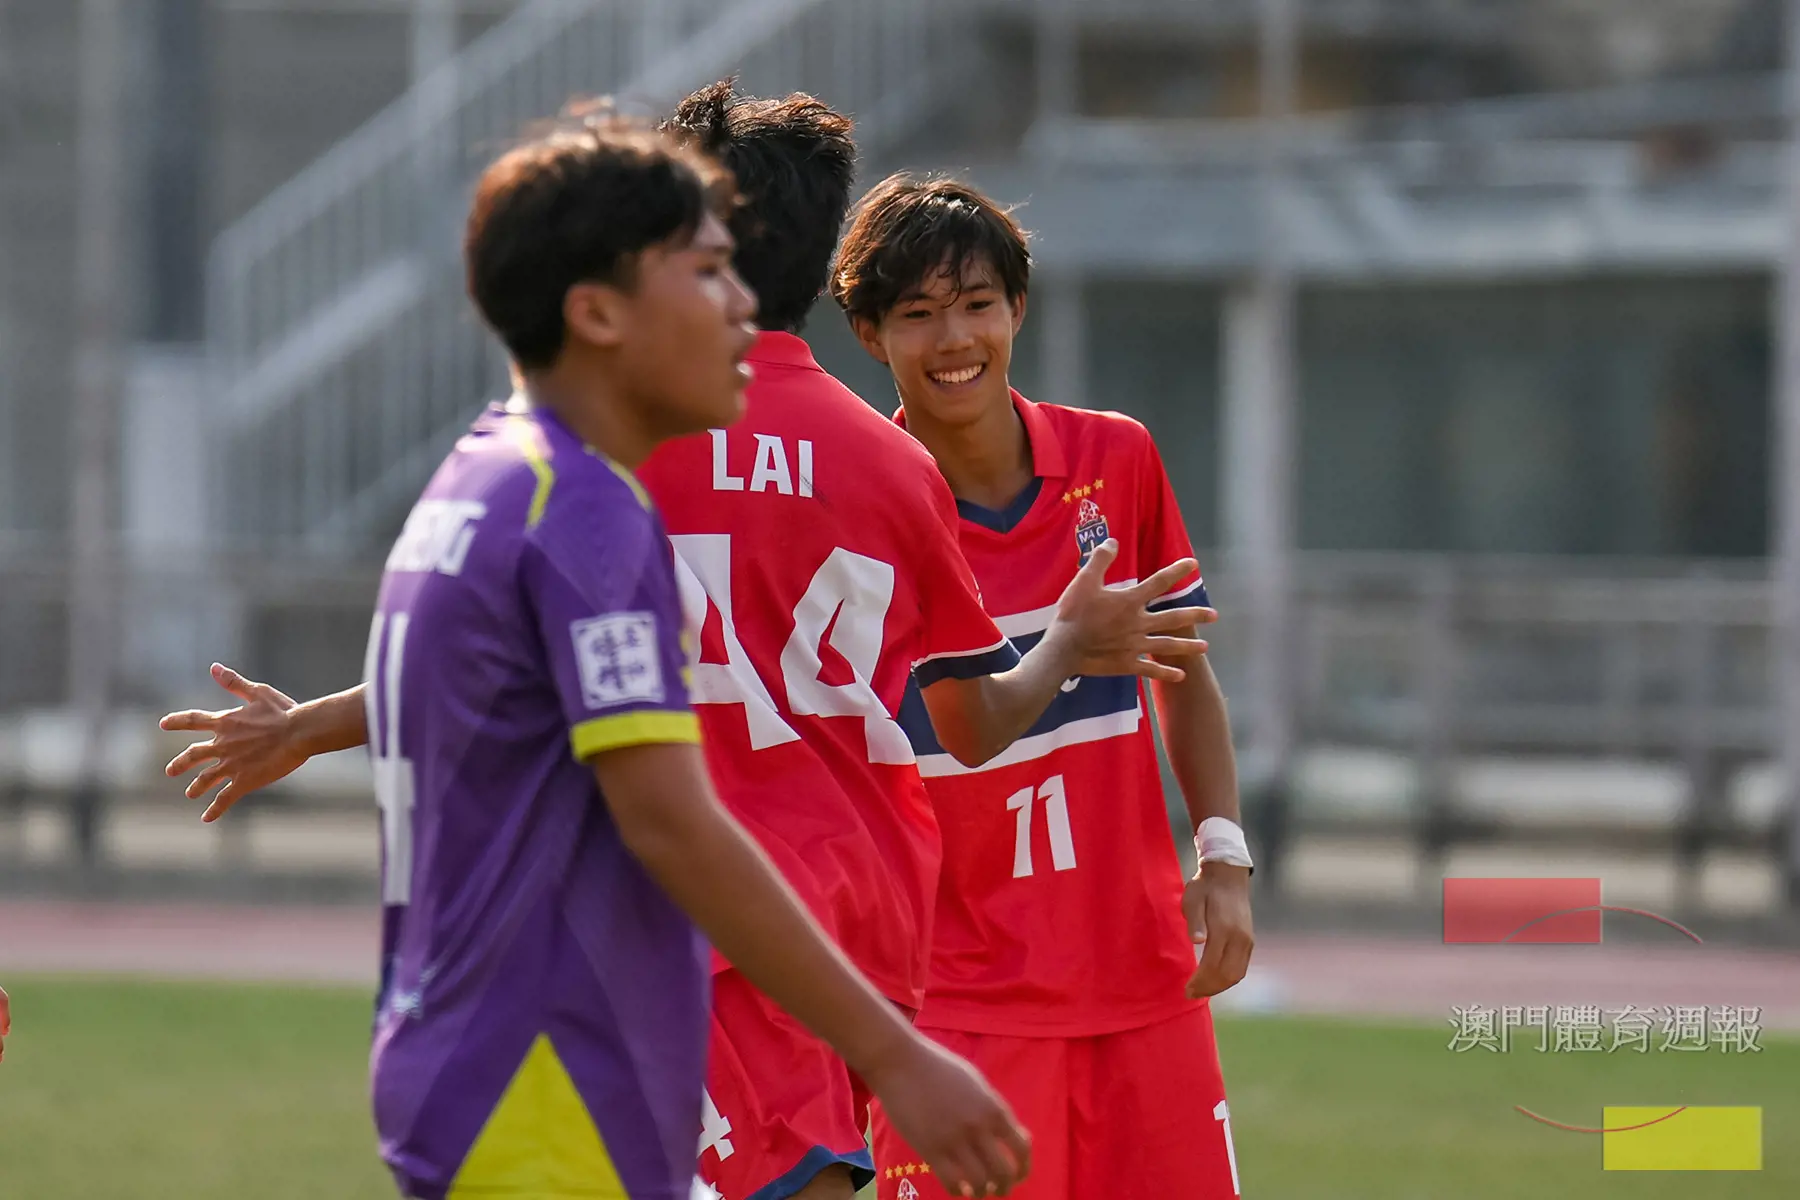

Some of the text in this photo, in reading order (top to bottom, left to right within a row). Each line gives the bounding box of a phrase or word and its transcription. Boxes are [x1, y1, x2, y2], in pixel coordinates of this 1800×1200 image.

[707, 428, 813, 498] LAI
[1078, 525, 1104, 544] MAC
[670, 534, 917, 765] 44
[1006, 774, 1077, 879] 11
